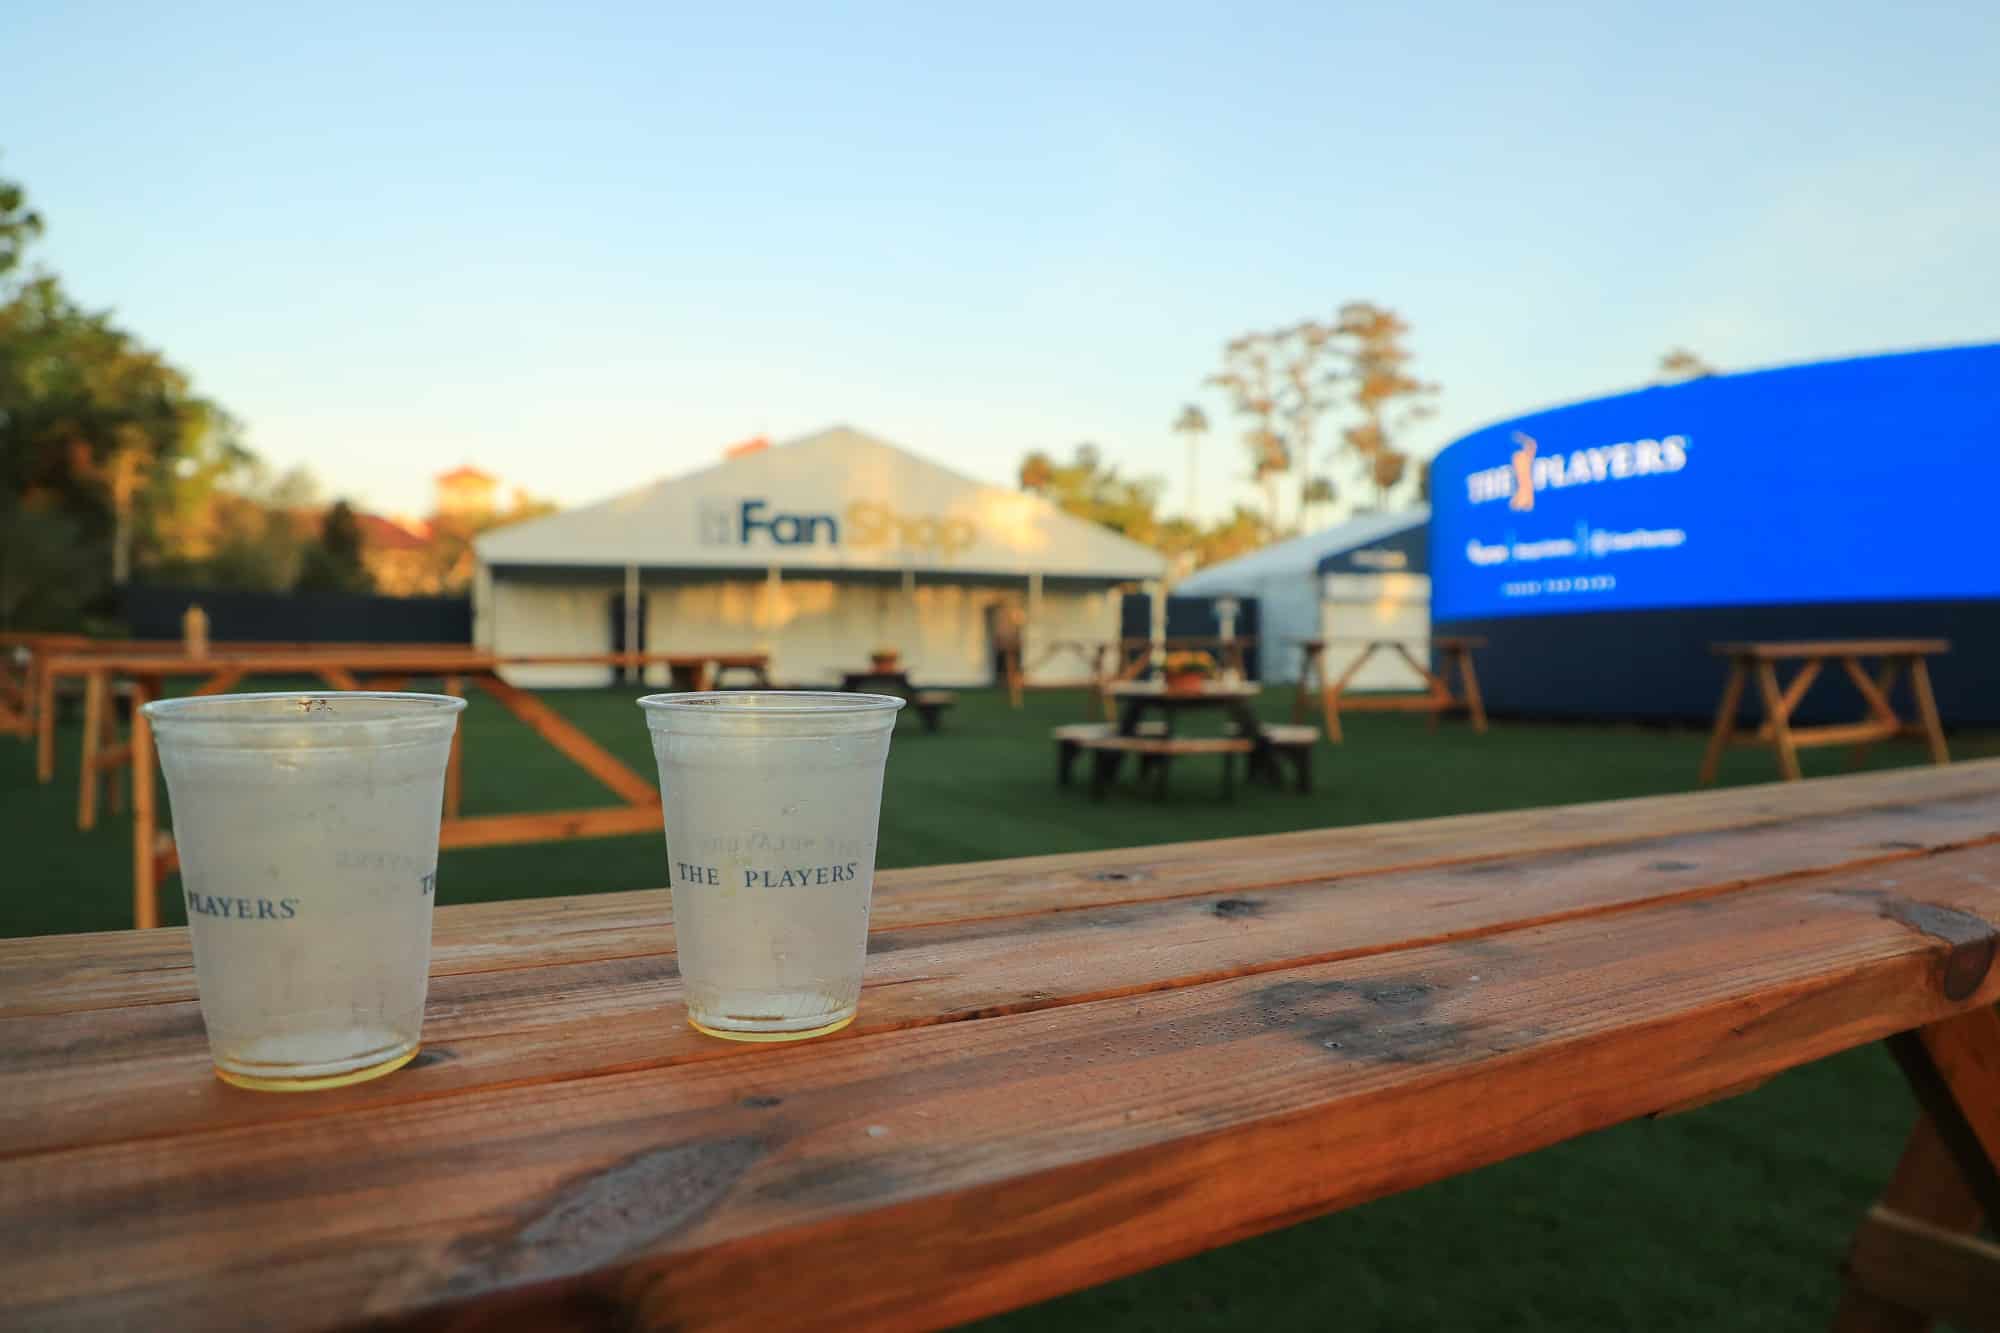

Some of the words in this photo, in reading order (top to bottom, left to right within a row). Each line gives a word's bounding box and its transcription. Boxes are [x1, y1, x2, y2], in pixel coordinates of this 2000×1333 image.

[1533, 435, 1688, 492] PLAYERS
[740, 499, 839, 545] Fan
[677, 861, 720, 886] THE
[744, 861, 857, 888] PLAYERS
